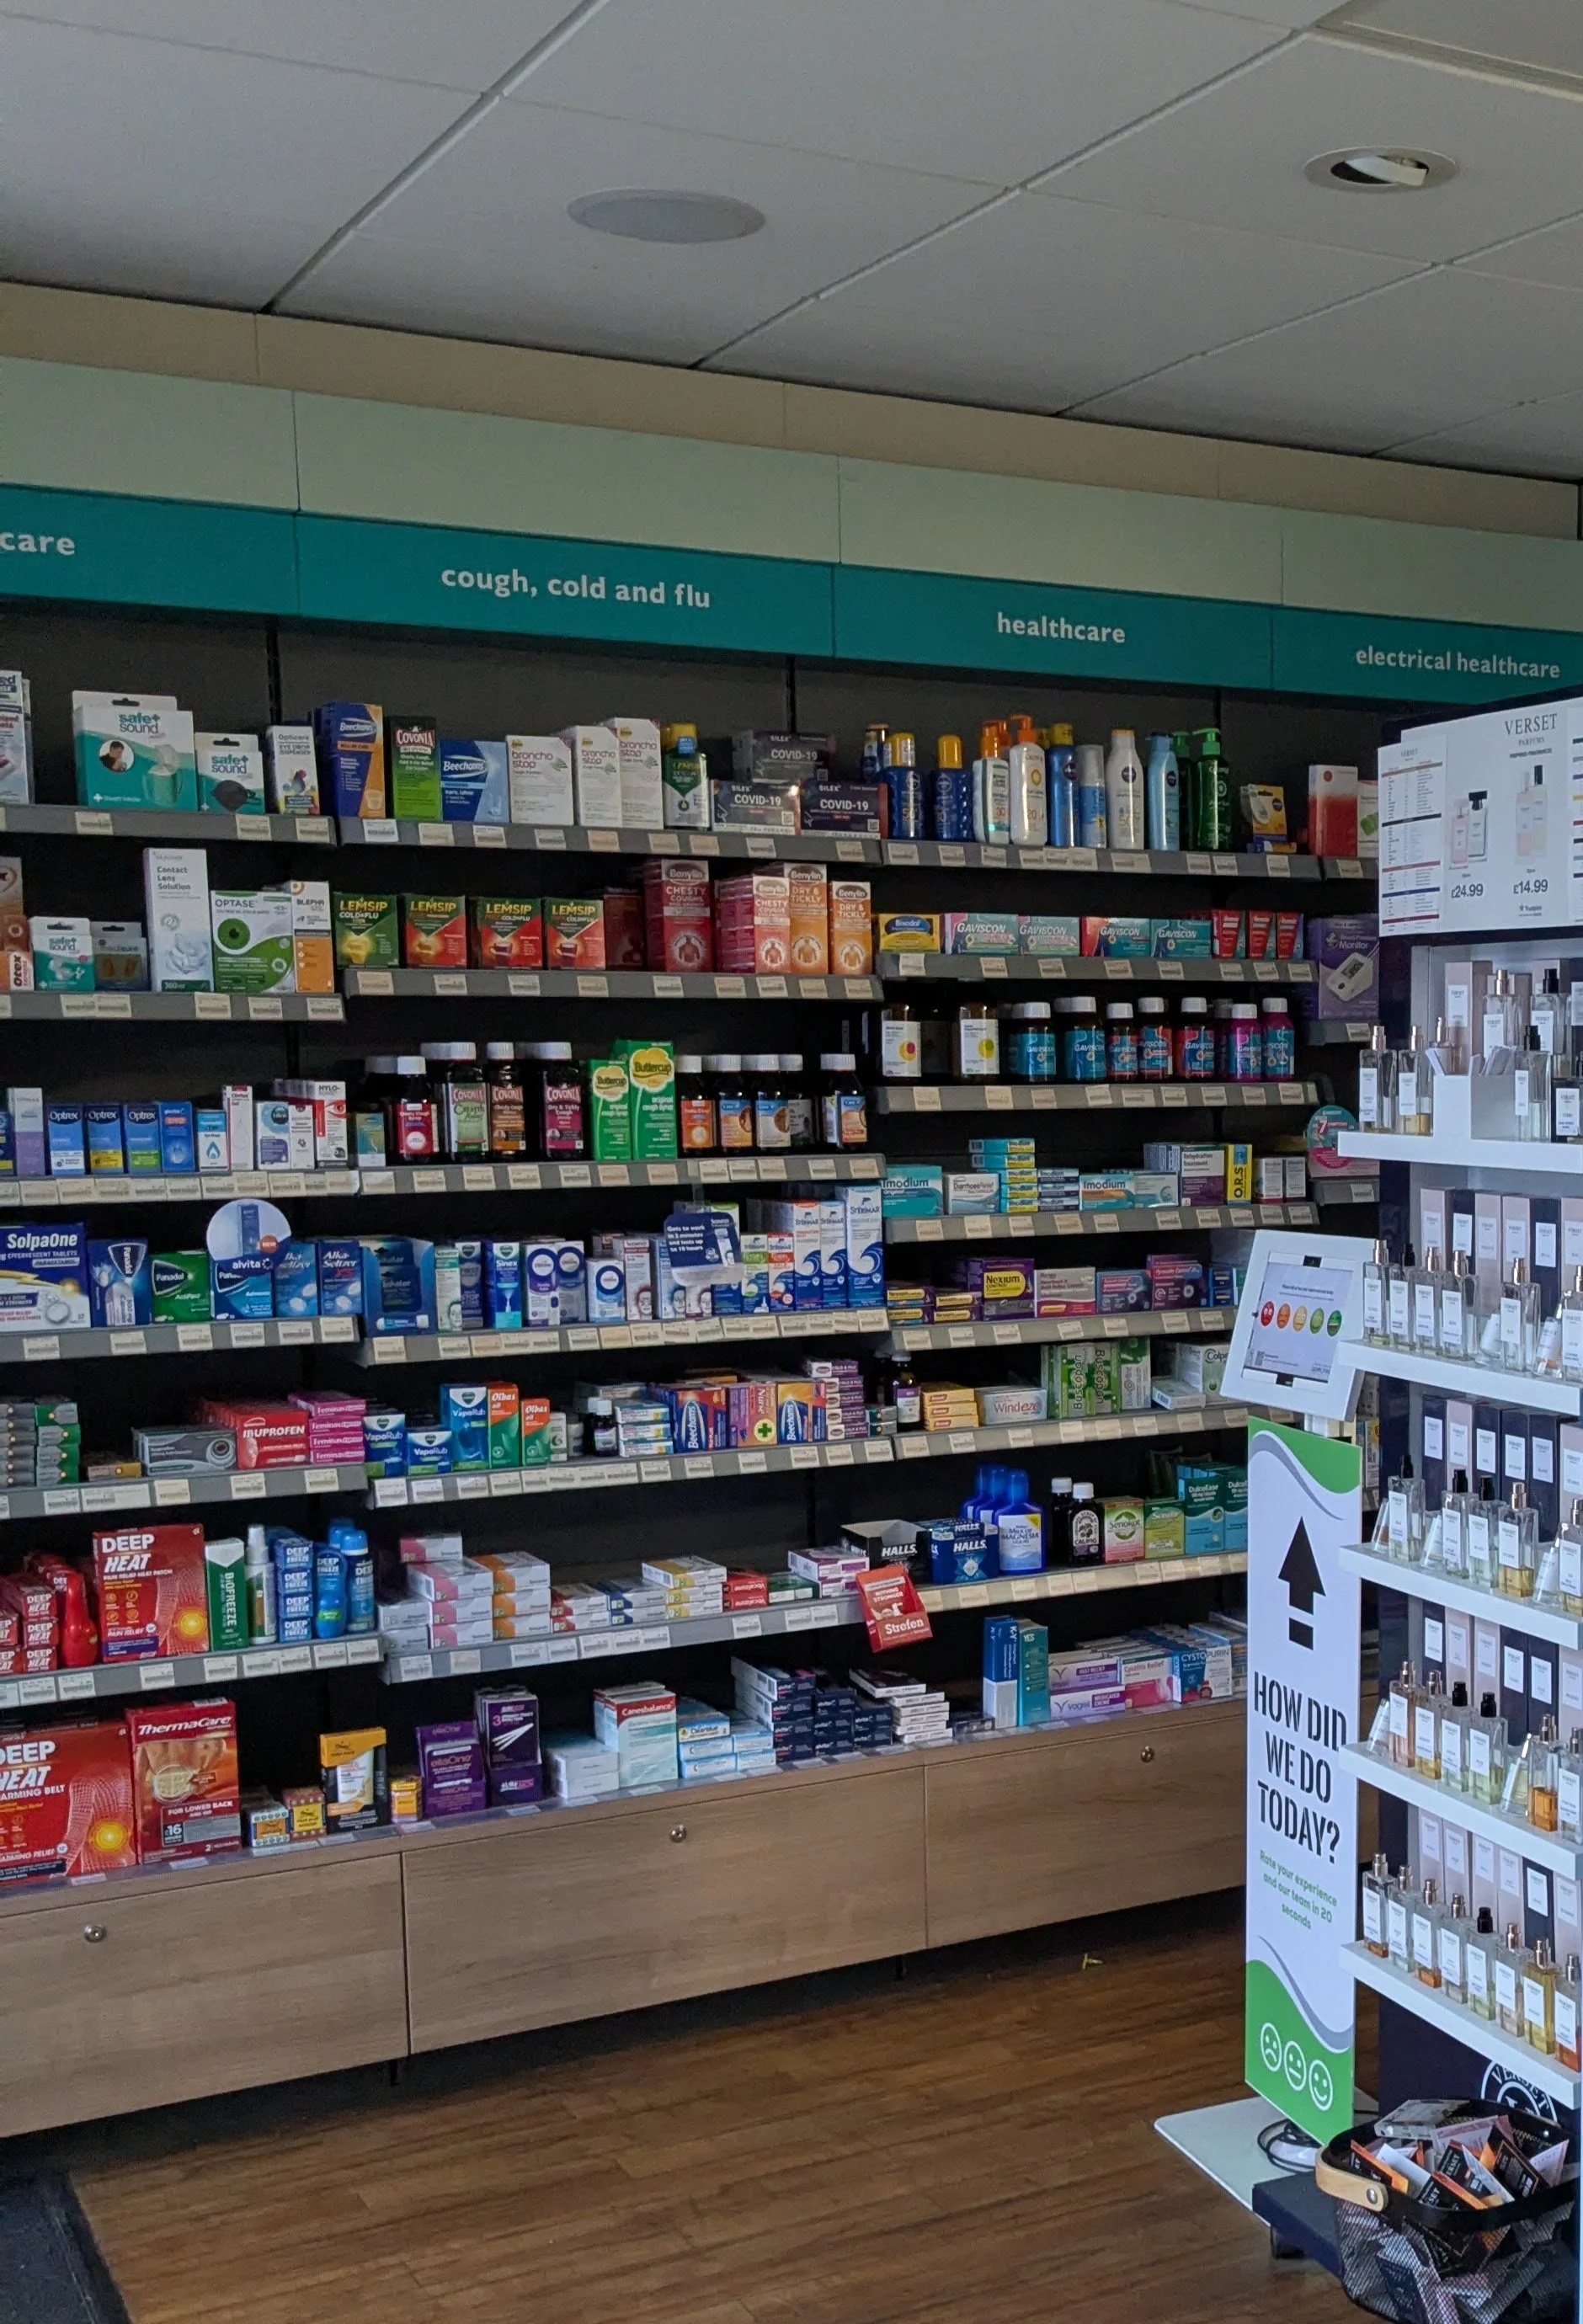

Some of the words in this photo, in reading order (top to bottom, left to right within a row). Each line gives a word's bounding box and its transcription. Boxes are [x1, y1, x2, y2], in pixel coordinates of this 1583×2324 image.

[0, 532, 75, 556] care
[441, 568, 538, 598] cough,
[547, 574, 605, 600] cold
[616, 583, 665, 604] and
[674, 583, 710, 608] flu
[997, 611, 1126, 643] healthcare
[1356, 645, 1452, 671] electrical
[1458, 653, 1559, 679] healthcare
[120, 723, 158, 734] sound
[1505, 713, 1558, 735] VERSET
[512, 751, 552, 760] broncho
[771, 750, 818, 760] COVID-19
[211, 764, 247, 774] sound
[443, 760, 485, 773] Beechams
[512, 760, 536, 769] stop
[734, 794, 781, 806] COVID-19
[819, 800, 869, 812] COVID-19
[669, 869, 703, 881] Benylin
[791, 870, 823, 881] Benylin
[666, 887, 706, 896] CHESTY
[792, 887, 812, 896] DRY
[1451, 883, 1484, 898] £24.99
[1513, 879, 1548, 894] £14.99
[215, 899, 253, 908] OPTASE
[756, 899, 789, 909] CHESTY
[791, 895, 822, 903] TICKLY
[339, 901, 387, 912] LEMSIP
[410, 901, 456, 912] LEMSIP
[486, 903, 532, 914] LEMSIP
[552, 904, 595, 915] LEMSIP
[840, 903, 856, 912] DRY
[839, 910, 866, 919] TICKLY
[957, 923, 1005, 933] GAVISCON
[1020, 925, 1067, 935] GAVISCON
[1100, 927, 1140, 938] GAVISCON
[1158, 930, 1197, 938] GAVISCON
[1339, 941, 1368, 950] Monitor
[635, 1062, 671, 1075] Buttercup
[597, 1077, 626, 1086] Buttercup
[49, 1111, 78, 1122] Optrex
[88, 1110, 117, 1121] Optrex
[129, 1111, 156, 1121] Optrex
[883, 1179, 929, 1188] Imodium
[1084, 1180, 1126, 1190] Imodium
[7, 1233, 78, 1251] SolpaOne
[232, 1261, 260, 1270] alvita
[156, 1273, 184, 1282] Panadol
[986, 1274, 1021, 1283] Nexium
[1074, 1355, 1083, 1410] Buscopan
[1095, 1349, 1105, 1405] Buscopan
[492, 1392, 515, 1402] Olbas
[453, 1408, 486, 1416] VapoRub
[994, 1402, 1042, 1414] Windeze
[688, 1405, 699, 1449] Beechams
[787, 1404, 797, 1441] Beechams
[243, 1426, 305, 1438] IBUPROFEN
[365, 1432, 402, 1442] VapoRub
[414, 1447, 448, 1456] VapoRub
[1188, 1484, 1219, 1493] DulcoEase
[955, 1522, 980, 1532] HALLS
[1109, 1520, 1140, 1529] Senokot
[101, 1534, 155, 1554] DEEP
[953, 1540, 987, 1553] HALLS
[286, 1546, 310, 1555] DEEP
[882, 1544, 917, 1557] HALLS
[104, 1554, 152, 1573] HEAT
[317, 1557, 339, 1565] DEEP
[285, 1572, 308, 1580] DEEP
[26, 1594, 52, 1604] DEEP
[224, 1572, 237, 1626] BIOFREEZE
[286, 1596, 310, 1606] DEEP
[28, 1602, 50, 1612] HEAT
[27, 1622, 53, 1633] DEEP
[285, 1620, 307, 1628] DEEP
[885, 1618, 924, 1634] Strefen
[28, 1631, 51, 1639] HEAT
[1024, 1633, 1035, 1641] YES
[26, 1649, 52, 1659] DEEP
[1181, 1650, 1229, 1663] CYSTOPURIN
[28, 1658, 51, 1666] HEAT
[621, 1702, 673, 1716] Canesbalance
[1254, 1671, 1303, 1733] HOW
[1308, 1697, 1346, 1752] DID
[138, 1716, 232, 1735] ThermaCare
[492, 1715, 502, 1726] 3
[1266, 1730, 1296, 1786] WE
[1300, 1748, 1331, 1804] DO
[44, 1785, 65, 1796] BELT
[184, 1803, 211, 1814] LOWER
[1257, 1780, 1340, 1864] TODAY?
[167, 1825, 182, 1835] 16
[1259, 1849, 1277, 1872] Rate
[1277, 1863, 1294, 1882] your
[1295, 1874, 1338, 1908] experience
[1263, 1873, 1277, 1890] and
[1278, 1880, 1291, 1897] our
[1292, 1889, 1310, 1911] team
[1312, 1902, 1319, 1916] in
[1320, 1907, 1333, 1923] 20
[1282, 1903, 1312, 1930] seconds
